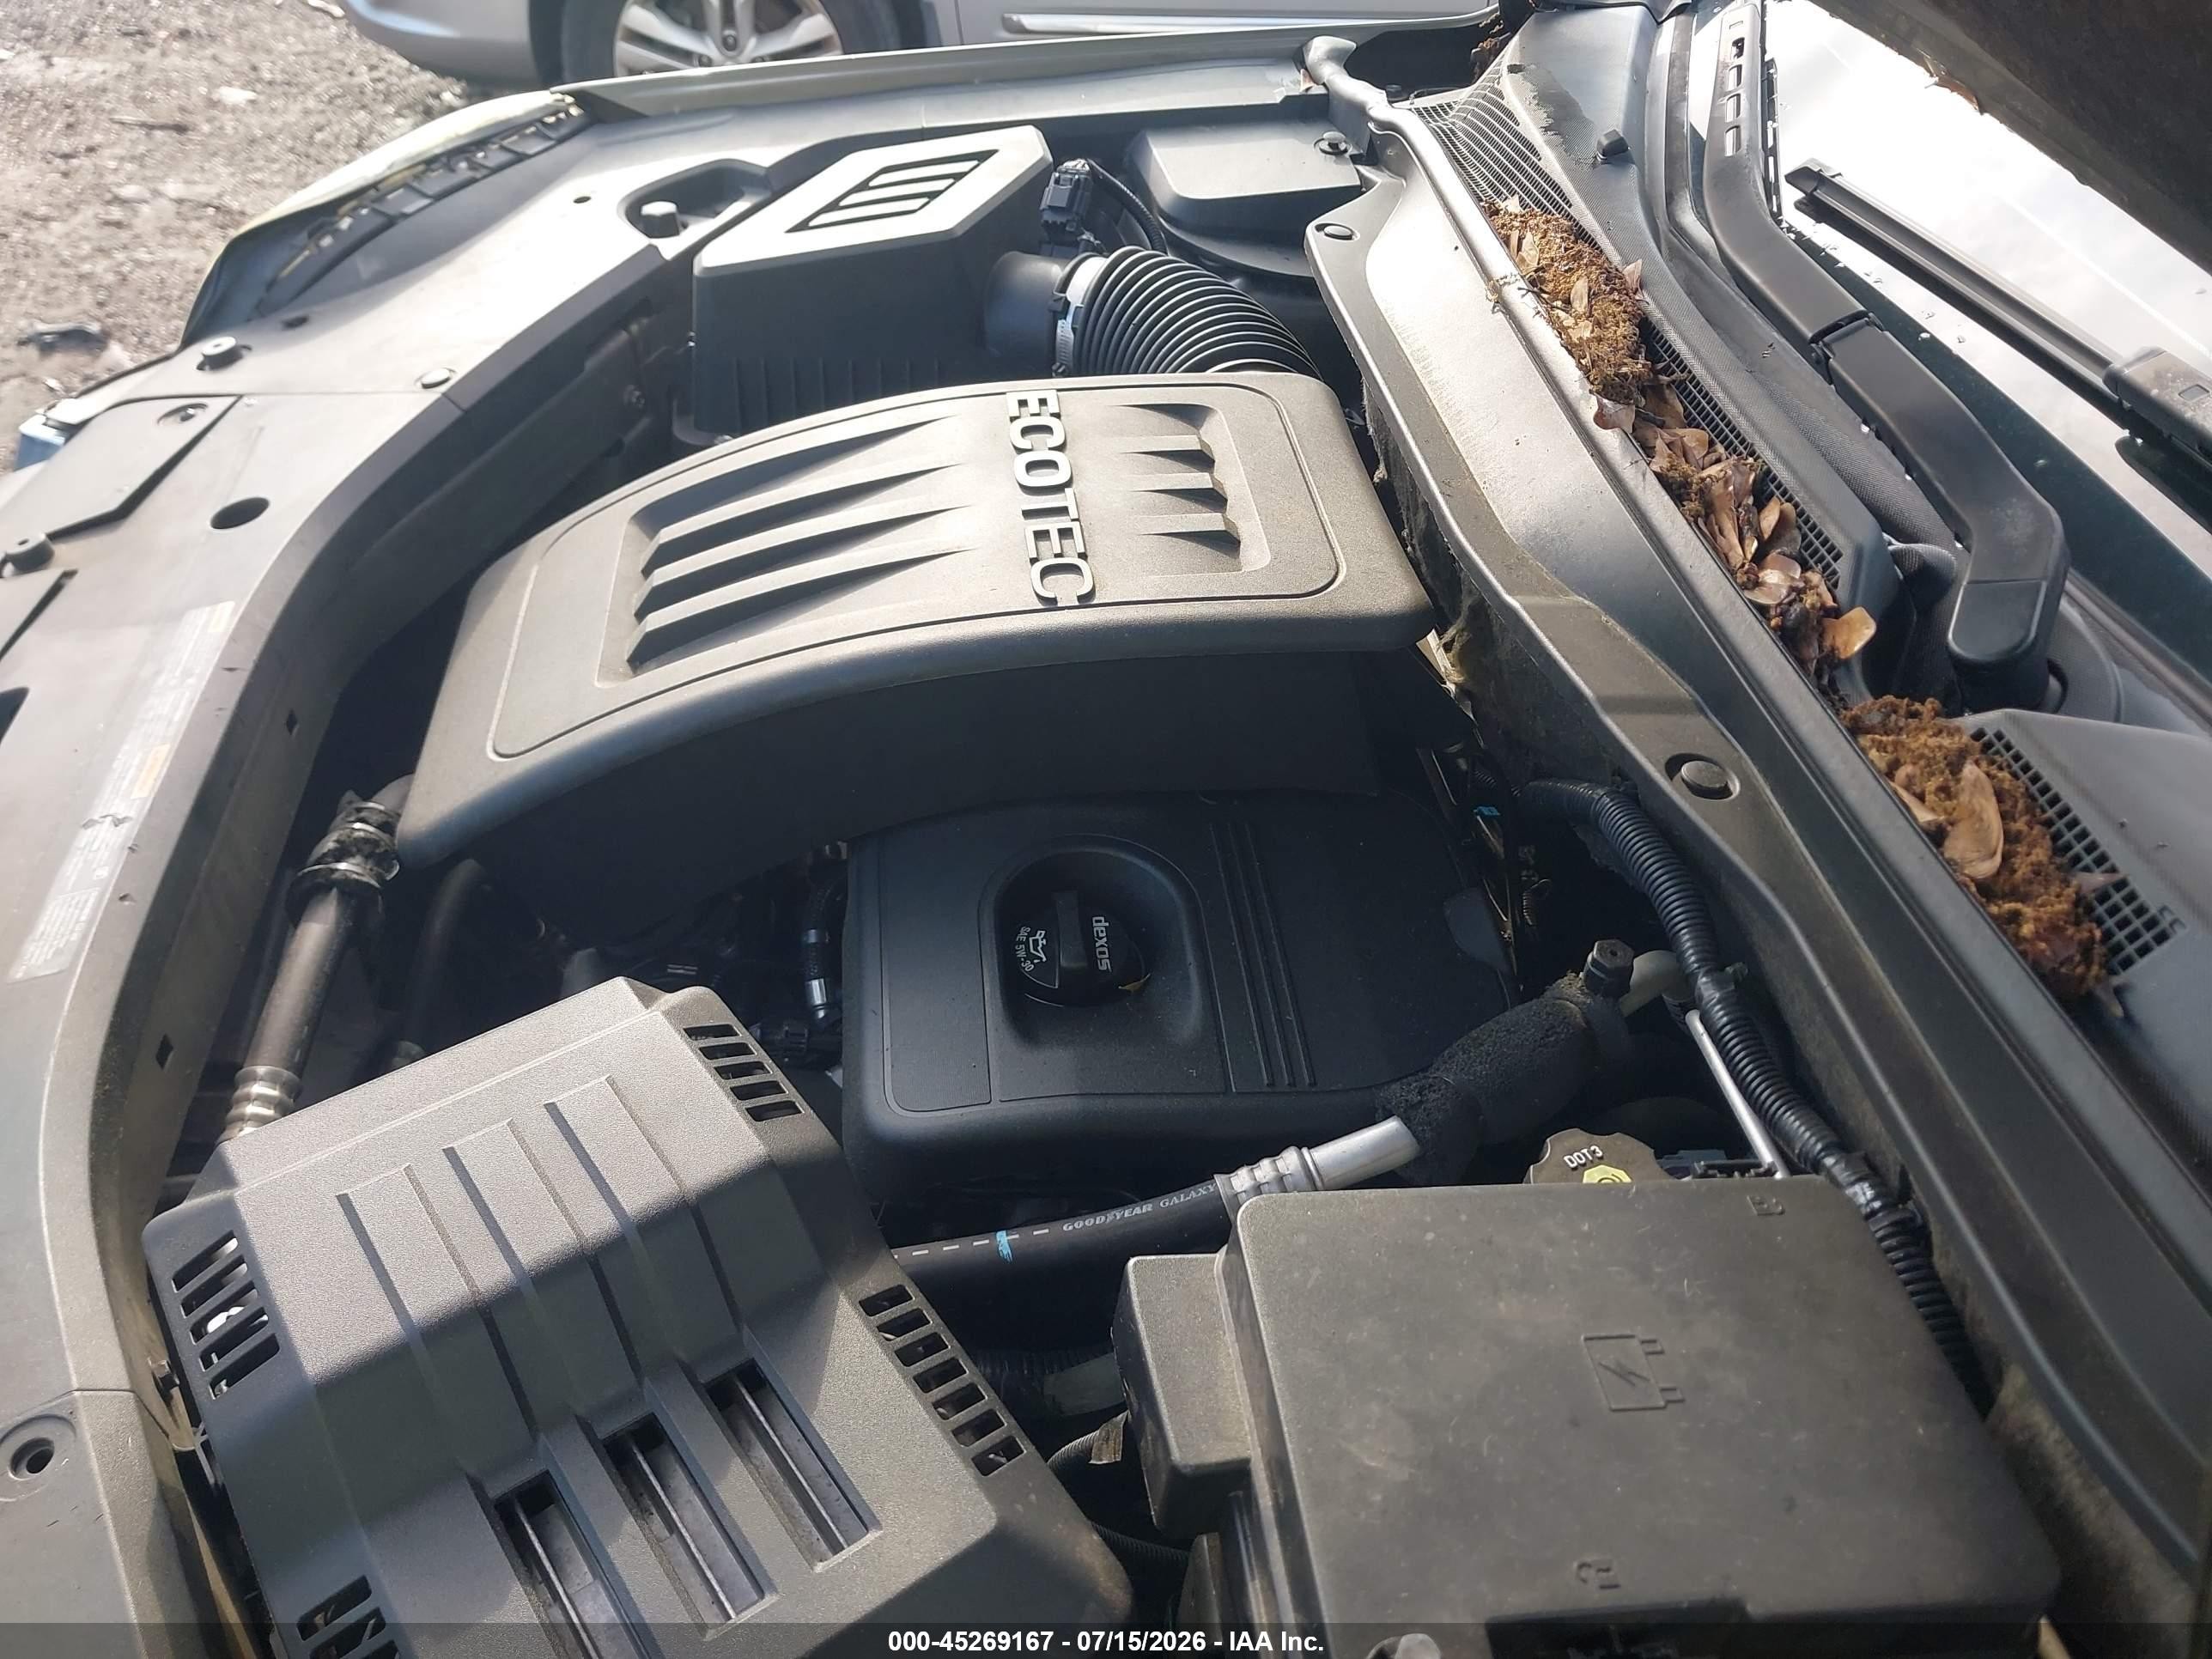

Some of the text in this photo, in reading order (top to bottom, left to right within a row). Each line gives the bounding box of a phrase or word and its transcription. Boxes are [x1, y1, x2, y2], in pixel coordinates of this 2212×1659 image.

[1006, 389, 1096, 606] ECOTEC
[1015, 926, 1035, 972] SAE 5W-30
[1091, 916, 1113, 972] dexos
[1062, 1183, 1217, 1231] GOODYEAR GALAXY
